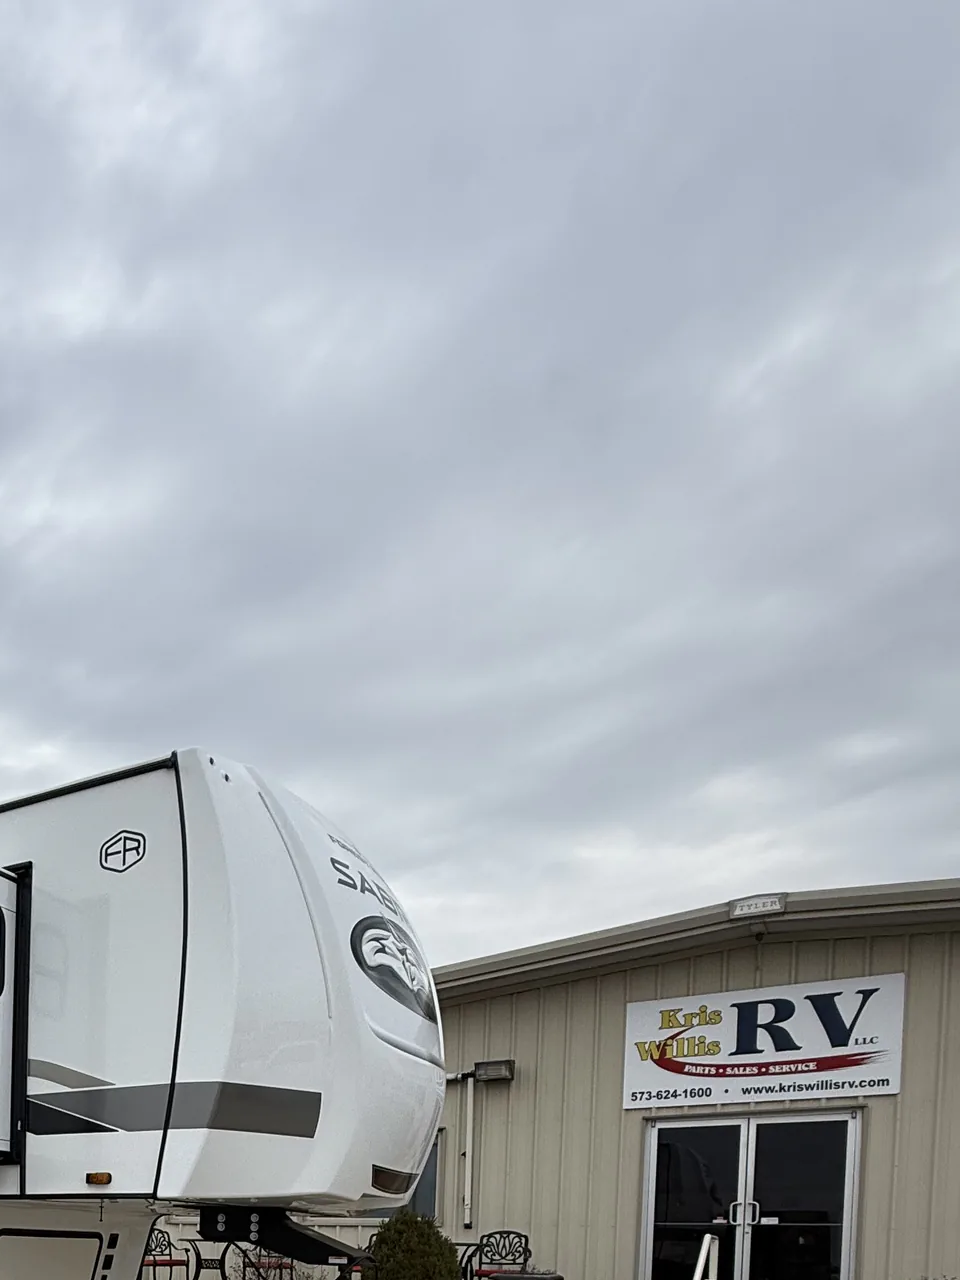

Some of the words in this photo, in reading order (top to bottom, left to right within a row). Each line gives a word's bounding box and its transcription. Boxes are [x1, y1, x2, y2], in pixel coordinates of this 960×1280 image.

[738, 900, 779, 912] TYLER
[658, 1005, 723, 1030] Kris
[728, 987, 881, 1057] RV
[634, 1035, 722, 1061] Willis
[854, 1036, 880, 1046] LLC
[683, 1064, 717, 1074] PARTS
[725, 1066, 759, 1075] SALES
[768, 1062, 818, 1074] SERVICE
[630, 1087, 713, 1102] 573-624-1600
[741, 1077, 890, 1095] www.kriswillisrv.com
